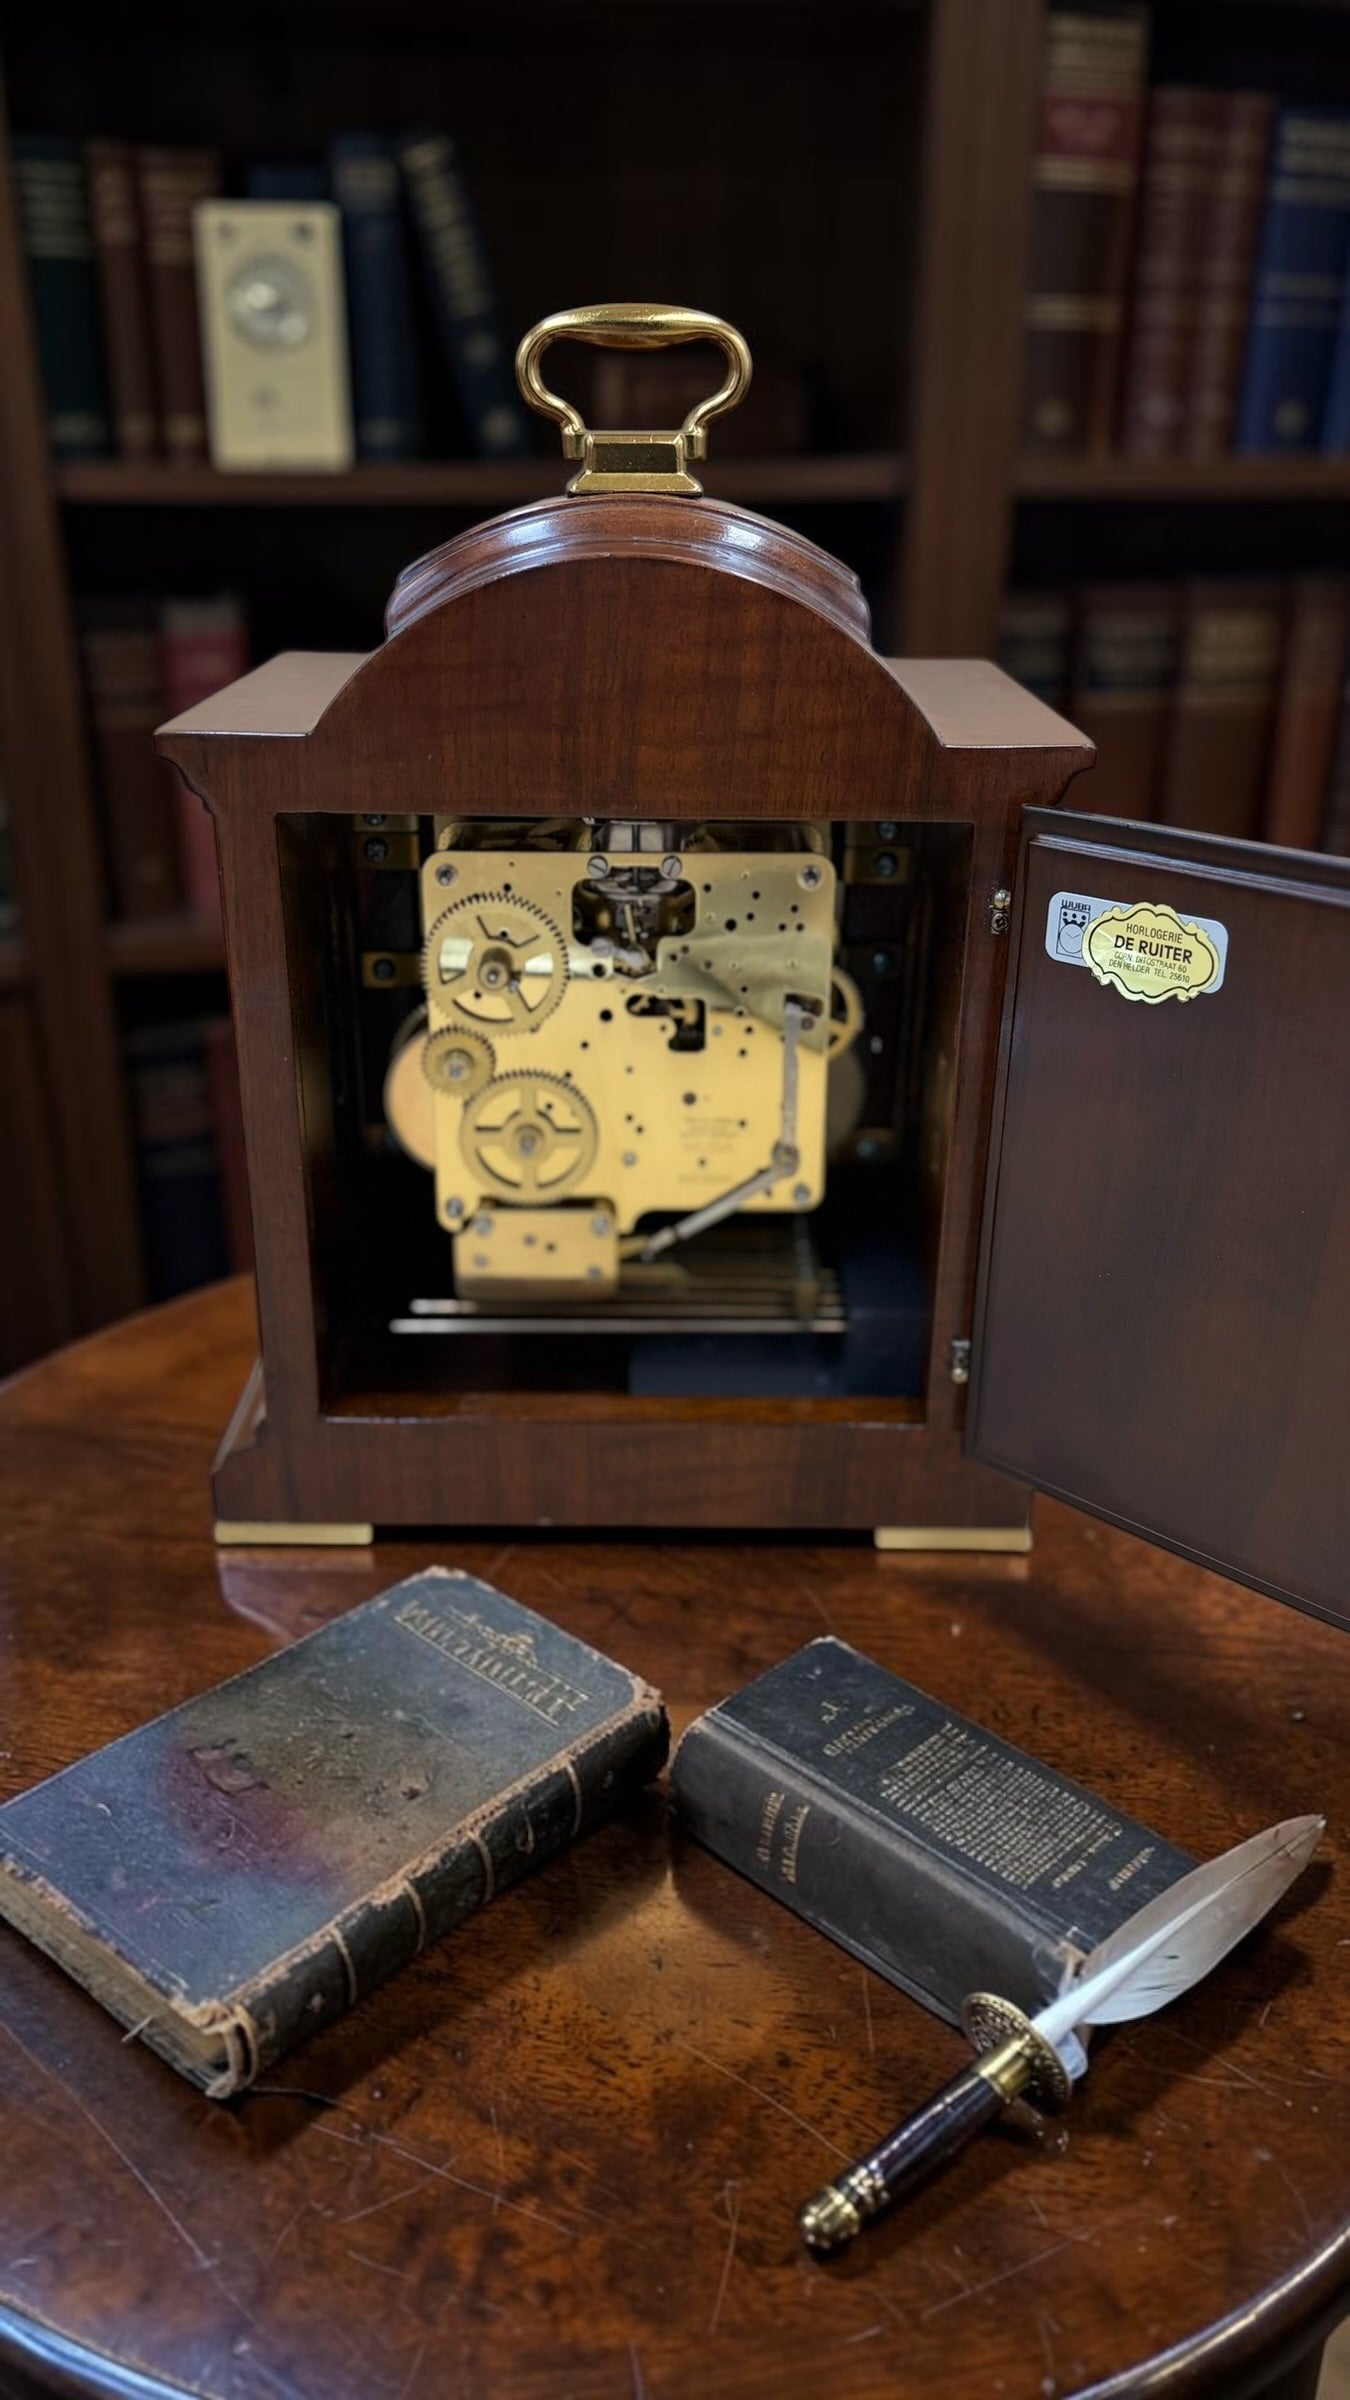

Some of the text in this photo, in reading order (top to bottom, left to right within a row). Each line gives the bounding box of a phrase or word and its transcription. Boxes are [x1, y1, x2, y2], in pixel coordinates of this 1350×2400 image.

[1126, 923, 1184, 944] HORLOGERIE
[1114, 935, 1193, 964] DE RUITER
[1108, 959, 1122, 969] DEN
[1123, 963, 1150, 975] HELDER
[1169, 971, 1190, 983] 25610
[1177, 964, 1187, 974] 60
